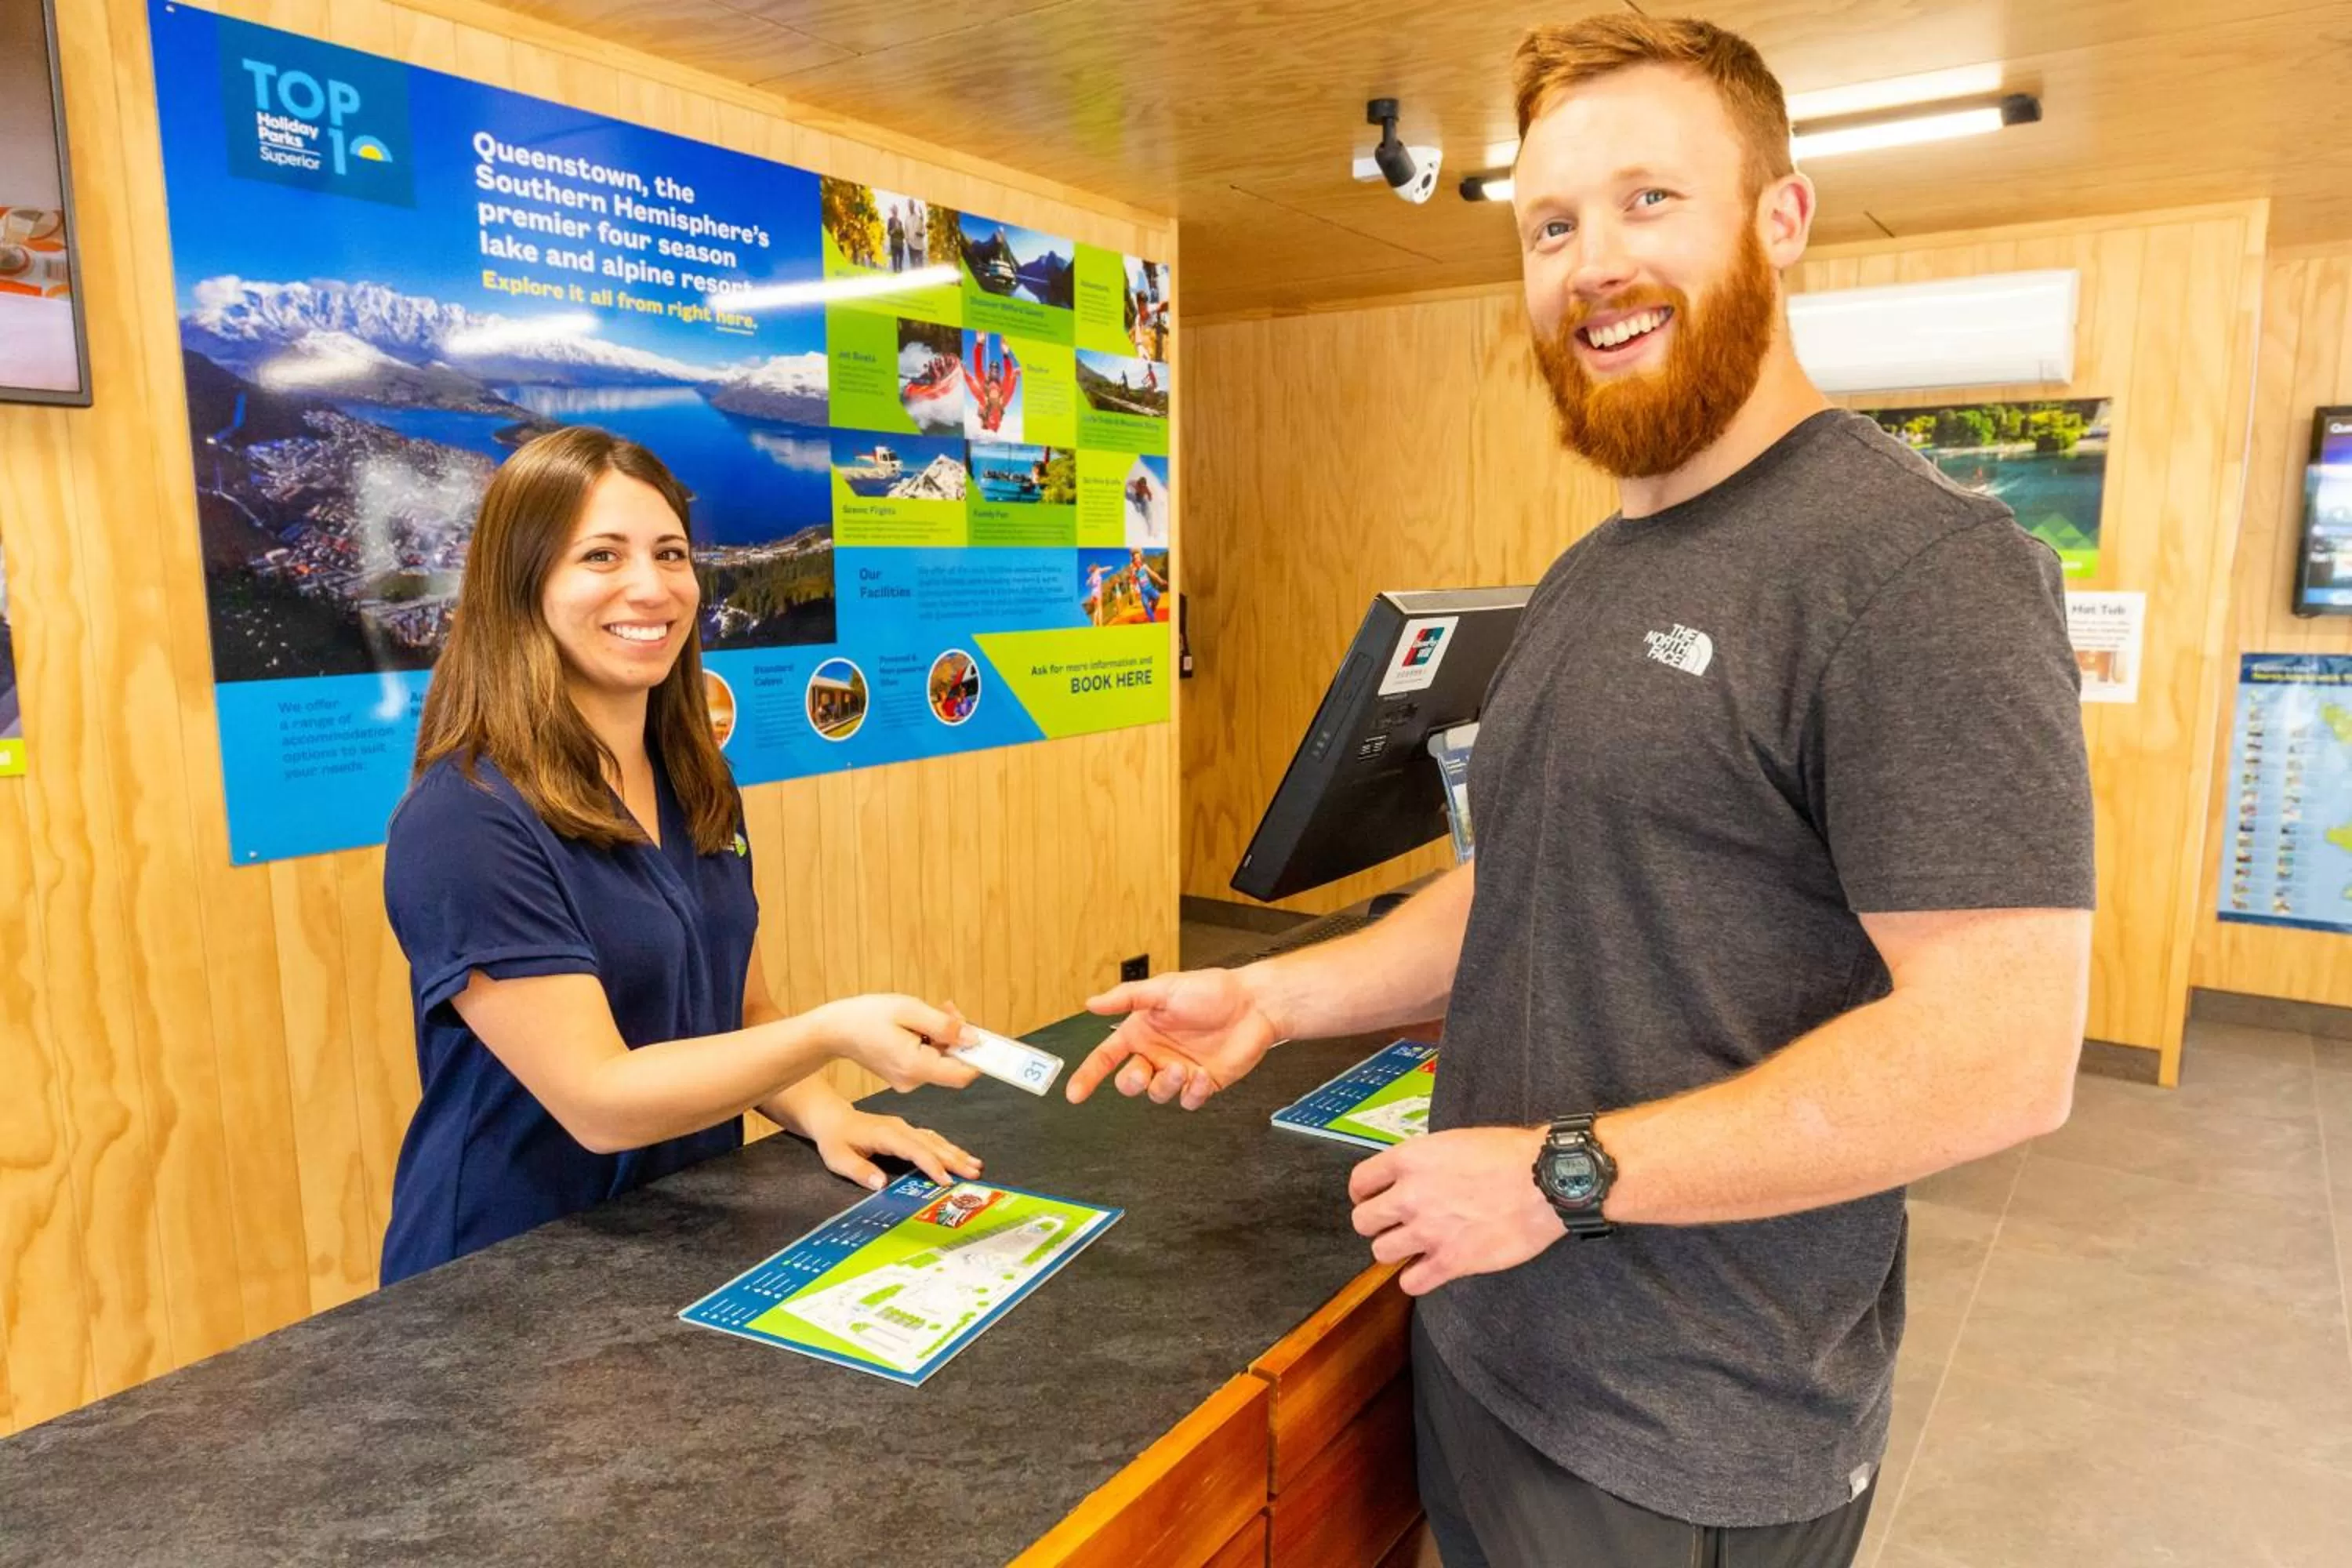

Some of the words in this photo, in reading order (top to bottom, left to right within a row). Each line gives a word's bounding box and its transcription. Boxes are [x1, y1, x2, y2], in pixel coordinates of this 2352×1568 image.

[241, 58, 361, 126] TOP
[256, 111, 319, 141] Holiday
[258, 126, 304, 148] Parks
[260, 146, 321, 171] Superior
[473, 132, 649, 198] Queenstown,
[654, 176, 695, 204] the
[475, 163, 608, 214] Southern
[613, 194, 771, 249] Hemisphere's
[477, 201, 591, 239] premier
[597, 220, 652, 251] four
[658, 238, 737, 268] season
[480, 230, 539, 263] lake
[546, 249, 595, 273] and
[602, 255, 675, 287] alpine
[482, 270, 564, 299] Explore
[569, 284, 586, 302] it
[590, 289, 612, 307] all
[617, 291, 663, 315] from
[668, 301, 713, 324] right
[859, 568, 882, 580] Our
[860, 586, 911, 599] Facilities
[1643, 630, 1690, 655] NORTH
[1671, 623, 1699, 643] THE
[1031, 665, 1047, 676] Ask
[1050, 664, 1063, 674] for
[1066, 662, 1087, 672] more
[1090, 657, 1137, 670] information
[1139, 655, 1153, 665] and
[1647, 646, 1683, 668] FACE
[1071, 675, 1112, 694] BOOK
[1116, 670, 1152, 688] HERE
[306, 698, 339, 710] offer
[292, 716, 335, 730] range
[339, 713, 352, 724] of
[282, 749, 338, 764] options
[342, 747, 356, 757] to
[361, 743, 387, 756] suit
[284, 767, 318, 782] your
[1024, 1061, 1047, 1081] 31
